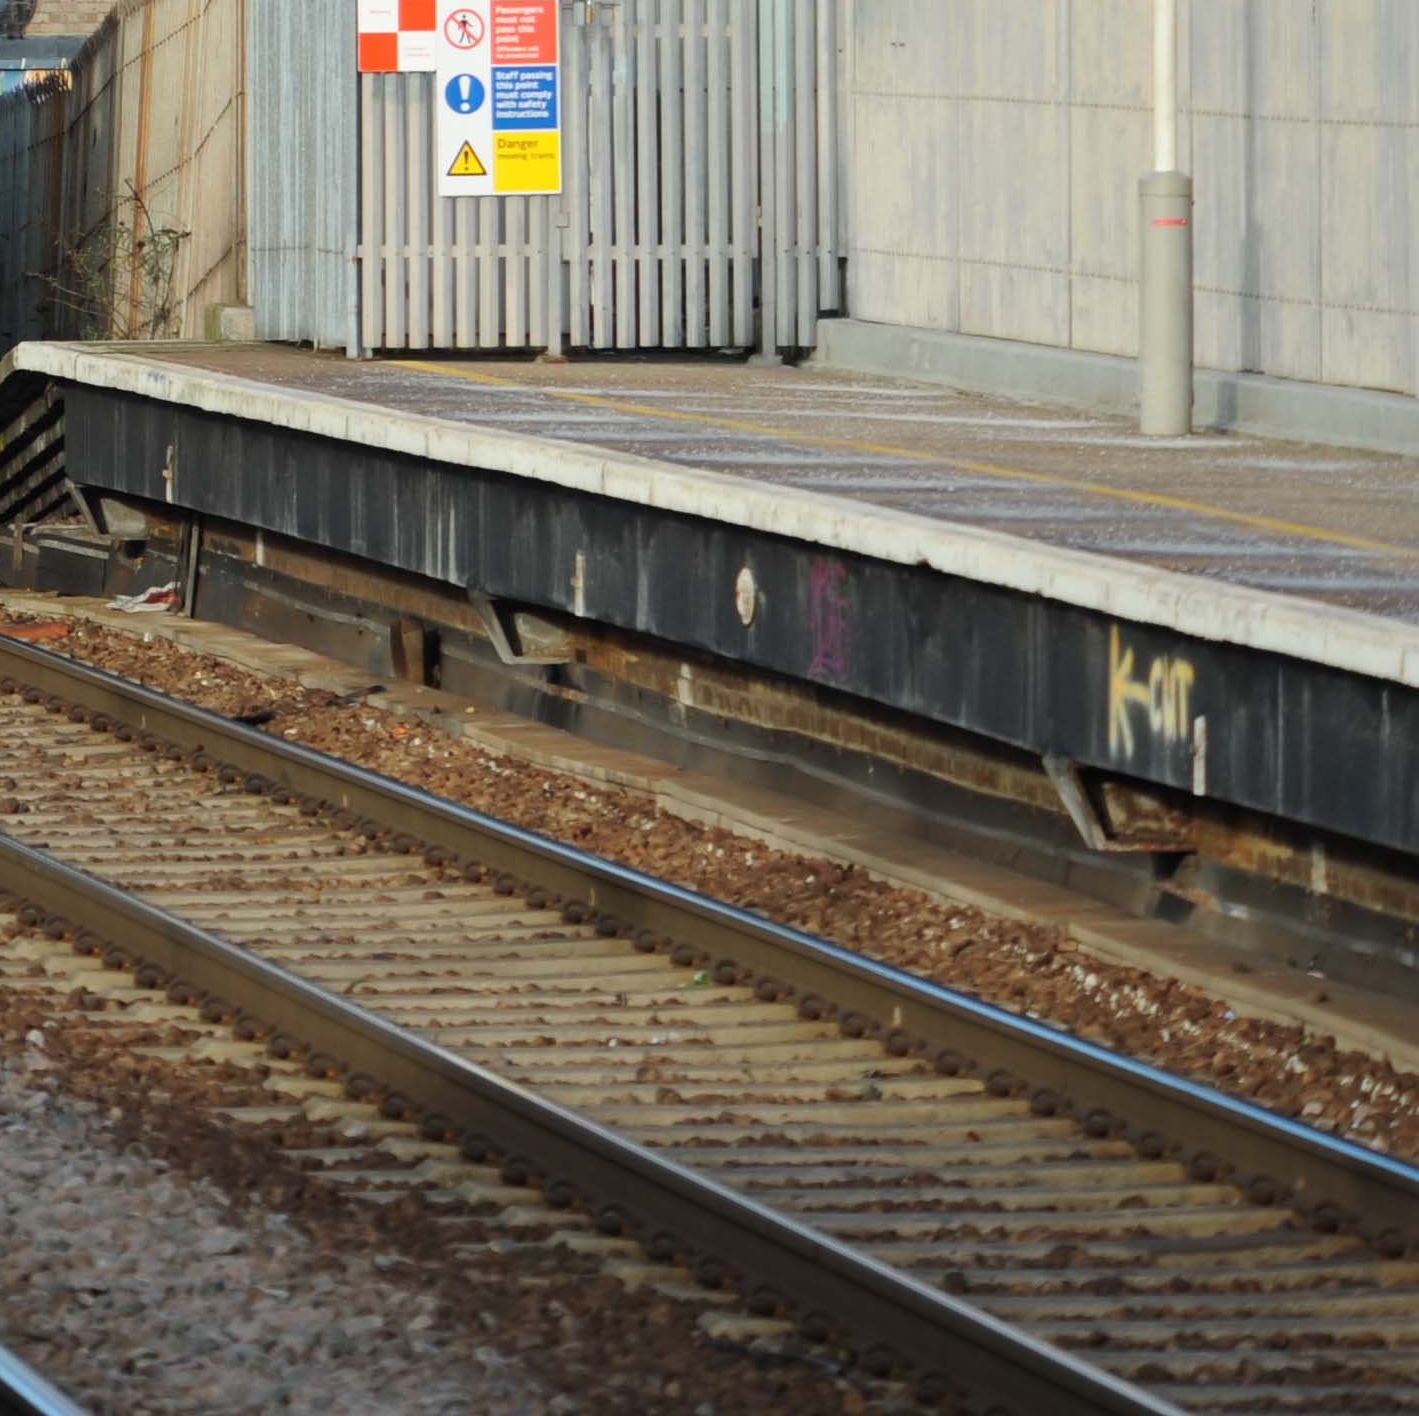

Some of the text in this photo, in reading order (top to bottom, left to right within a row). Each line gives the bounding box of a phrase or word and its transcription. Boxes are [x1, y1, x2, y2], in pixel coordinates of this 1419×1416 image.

[495, 6, 544, 16] Passengers
[495, 16, 537, 24] must not
[495, 25, 535, 34] pass this
[495, 35, 520, 44] point
[496, 71, 554, 81] Staff passing
[496, 81, 539, 90] this point
[496, 91, 553, 100] must comply
[496, 101, 547, 110] with safety
[496, 110, 550, 119] instructions
[497, 138, 539, 151] Danger
